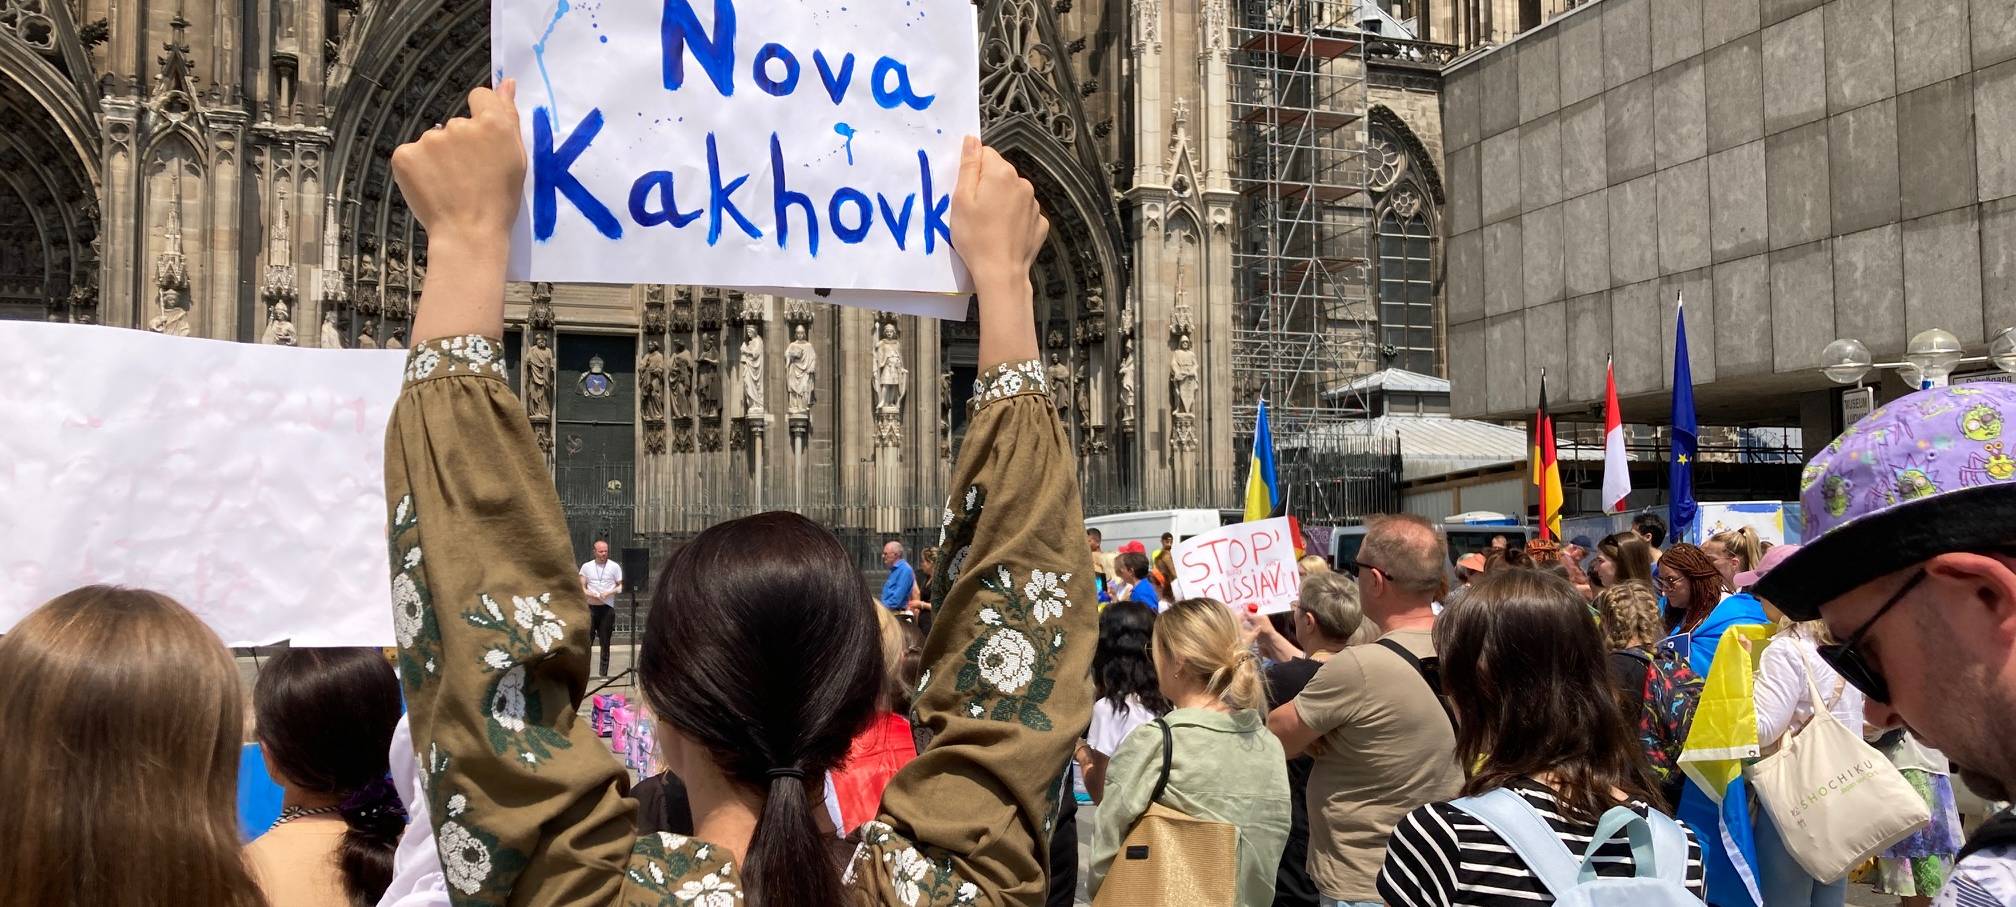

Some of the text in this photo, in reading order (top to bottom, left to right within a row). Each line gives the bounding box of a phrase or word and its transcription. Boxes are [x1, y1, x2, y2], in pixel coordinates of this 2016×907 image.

[660, 0, 936, 111] Nova
[531, 105, 954, 258] Kakhovk
[1844, 397, 1868, 410] MUSEUM
[1800, 759, 1873, 810] SHOCHIKU
